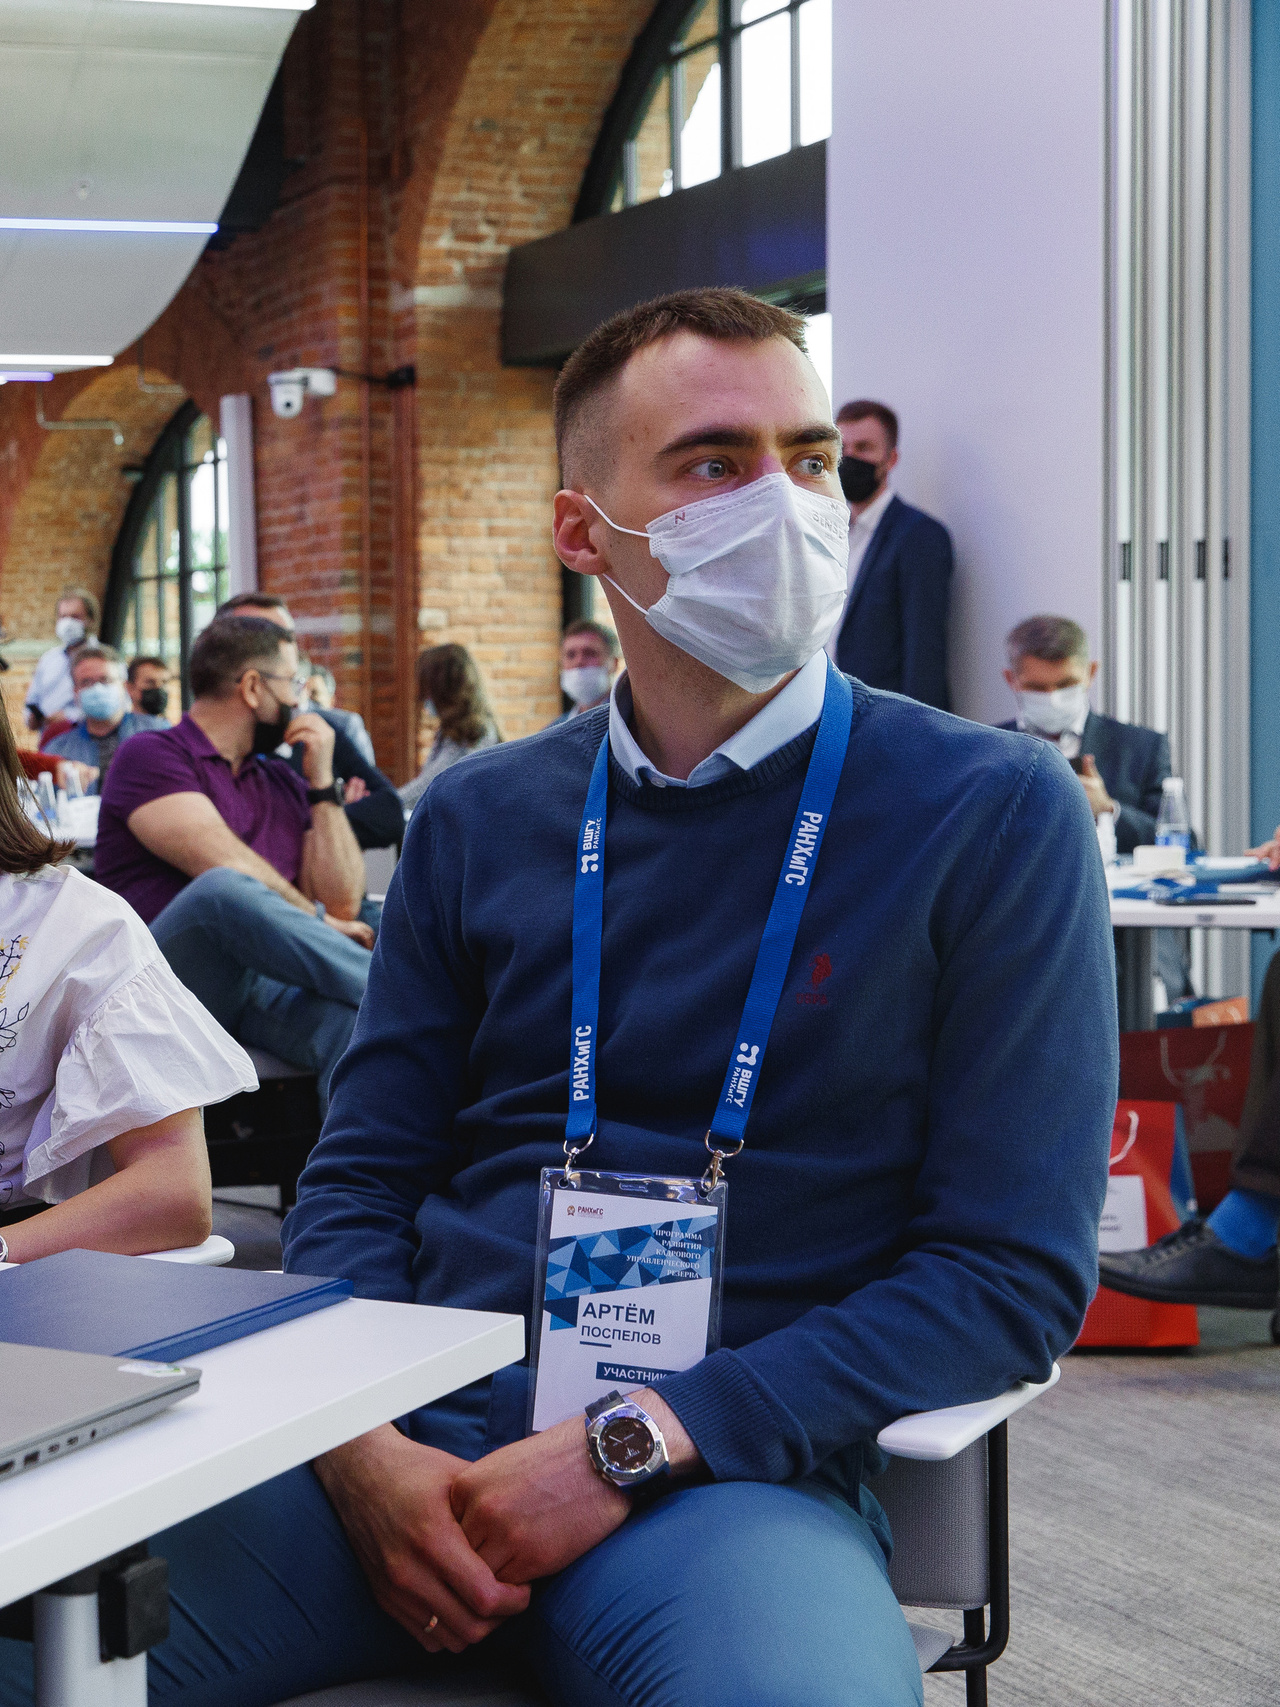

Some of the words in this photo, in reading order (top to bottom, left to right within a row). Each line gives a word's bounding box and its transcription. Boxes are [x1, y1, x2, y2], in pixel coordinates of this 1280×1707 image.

[582, 819, 596, 850] ВШГУ
[592, 817, 602, 849] РАНХиГС
[784, 811, 823, 886] РАНХиГС
[573, 1025, 592, 1101] РАНХиГС
[725, 1067, 741, 1104] РАНХиГС
[734, 1068, 753, 1108] ВШГУ
[578, 1206, 604, 1216] РАНХиГС
[656, 1230, 702, 1241] ПРОГРАММА
[661, 1240, 702, 1250] РАЗВИТИЯ
[626, 1255, 700, 1269] УПРАВЛЕНЧЕСКОГО
[656, 1248, 701, 1259] КАДРОВОГО
[666, 1270, 699, 1279] РЕЗЕРВА
[582, 1301, 656, 1326] АРТЁМ
[581, 1325, 662, 1345] ПОСПЕЛОВ
